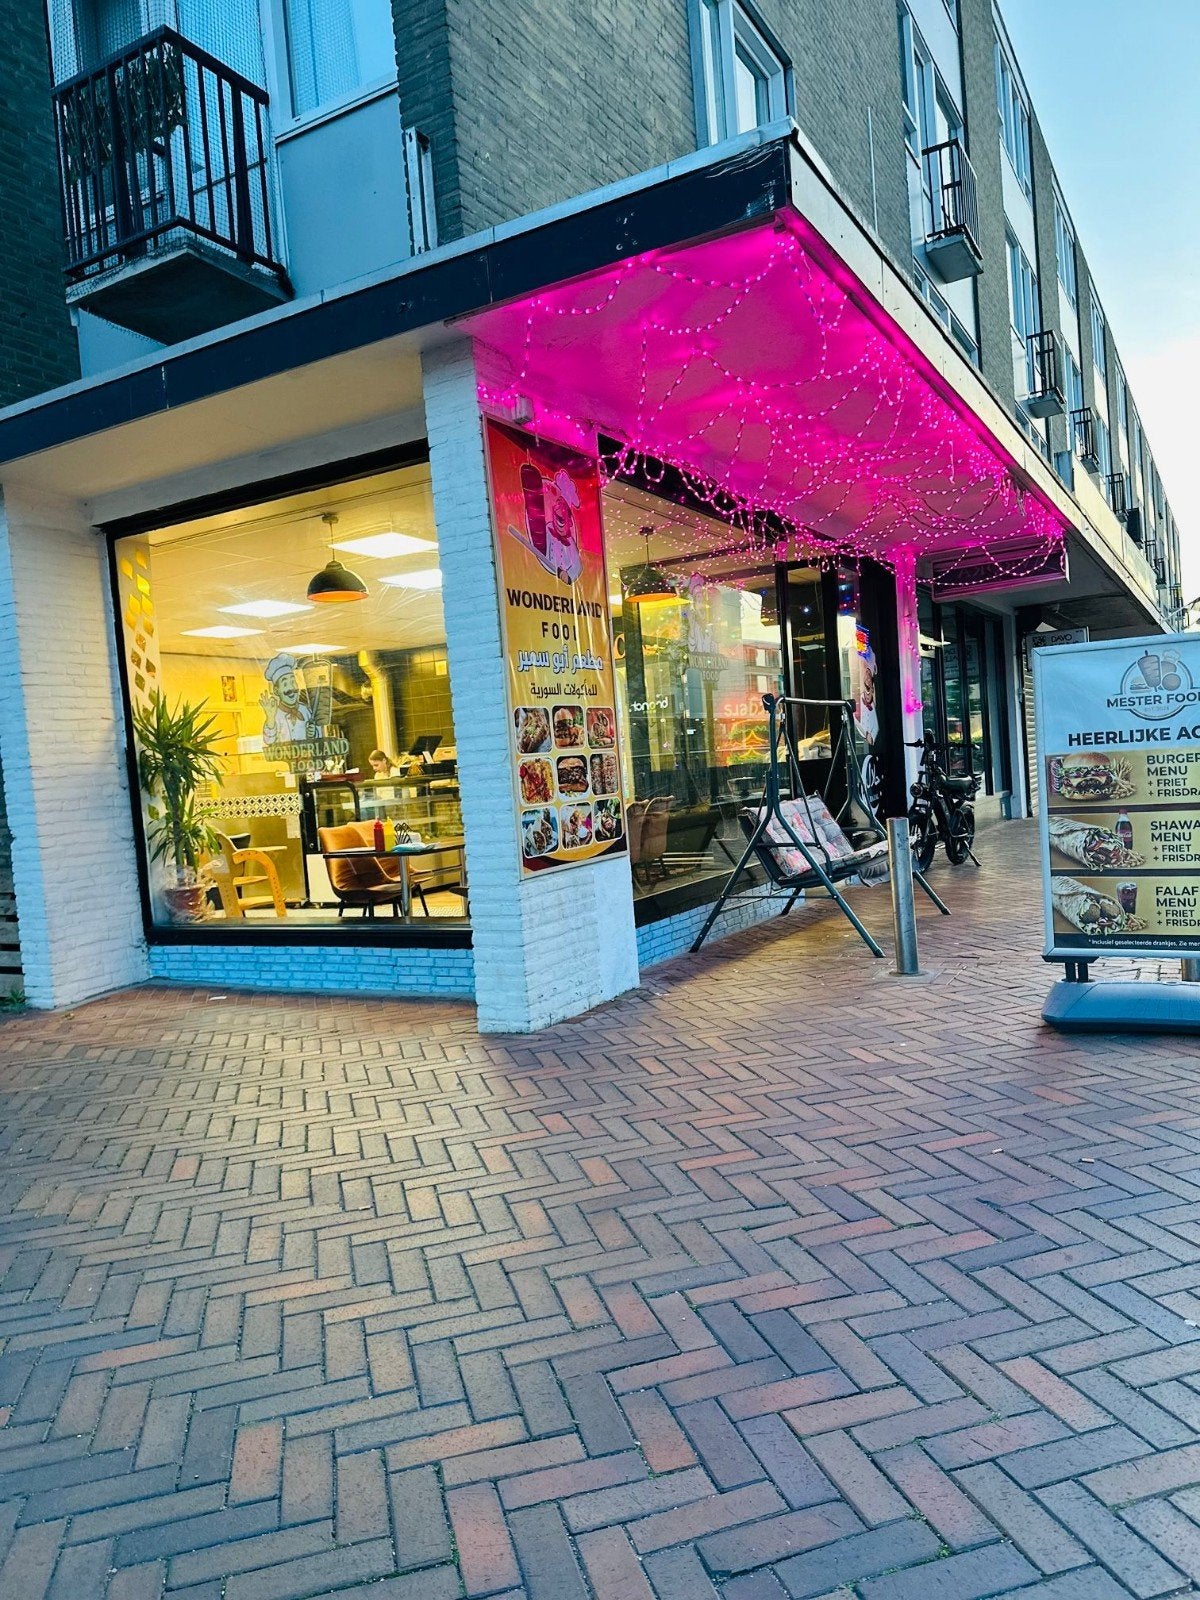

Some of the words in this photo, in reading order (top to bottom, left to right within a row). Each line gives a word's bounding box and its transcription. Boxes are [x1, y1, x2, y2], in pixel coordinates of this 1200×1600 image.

[517, 649, 551, 672] سمير
[552, 644, 570, 674] أبو
[530, 682, 562, 699] السورية
[1106, 694, 1162, 708] MESTER
[1166, 691, 1200, 704] FOO
[1068, 727, 1171, 747] HEERLIJKE
[264, 738, 350, 761] WONDERLAND
[290, 760, 324, 773] FOOD
[1147, 765, 1188, 777] MENU
[1157, 778, 1188, 787] FRIET
[1151, 831, 1192, 842] MENU
[1162, 844, 1192, 853] FRIET
[1155, 886, 1199, 896] FALAF
[1156, 897, 1197, 908] MENU
[1165, 909, 1195, 918] FRIET
